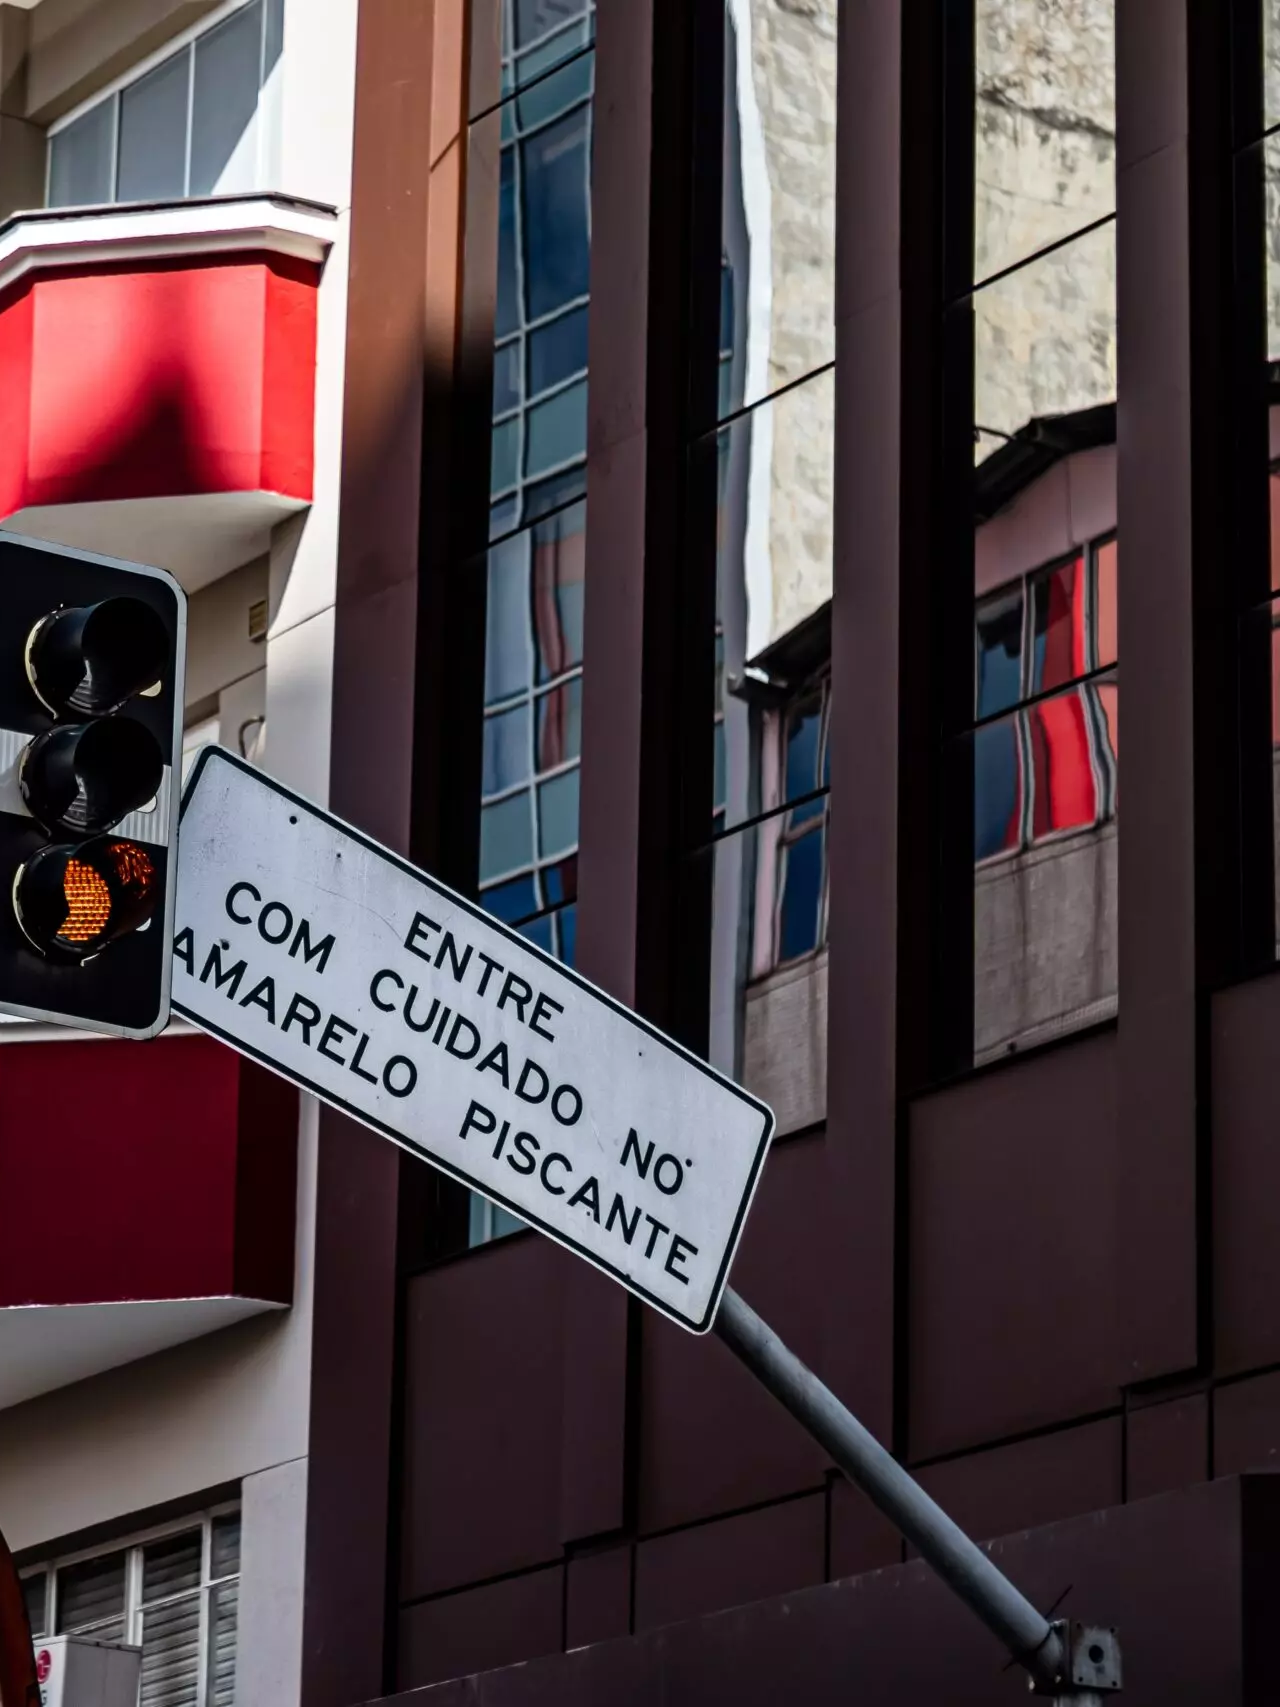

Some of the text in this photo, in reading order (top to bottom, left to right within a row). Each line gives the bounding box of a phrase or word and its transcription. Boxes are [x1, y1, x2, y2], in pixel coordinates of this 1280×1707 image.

[172, 926, 699, 1286] AMARELO PISCANTE
[224, 881, 684, 1196] COM CUIDADO NO
[404, 911, 565, 1043] ENTRE
